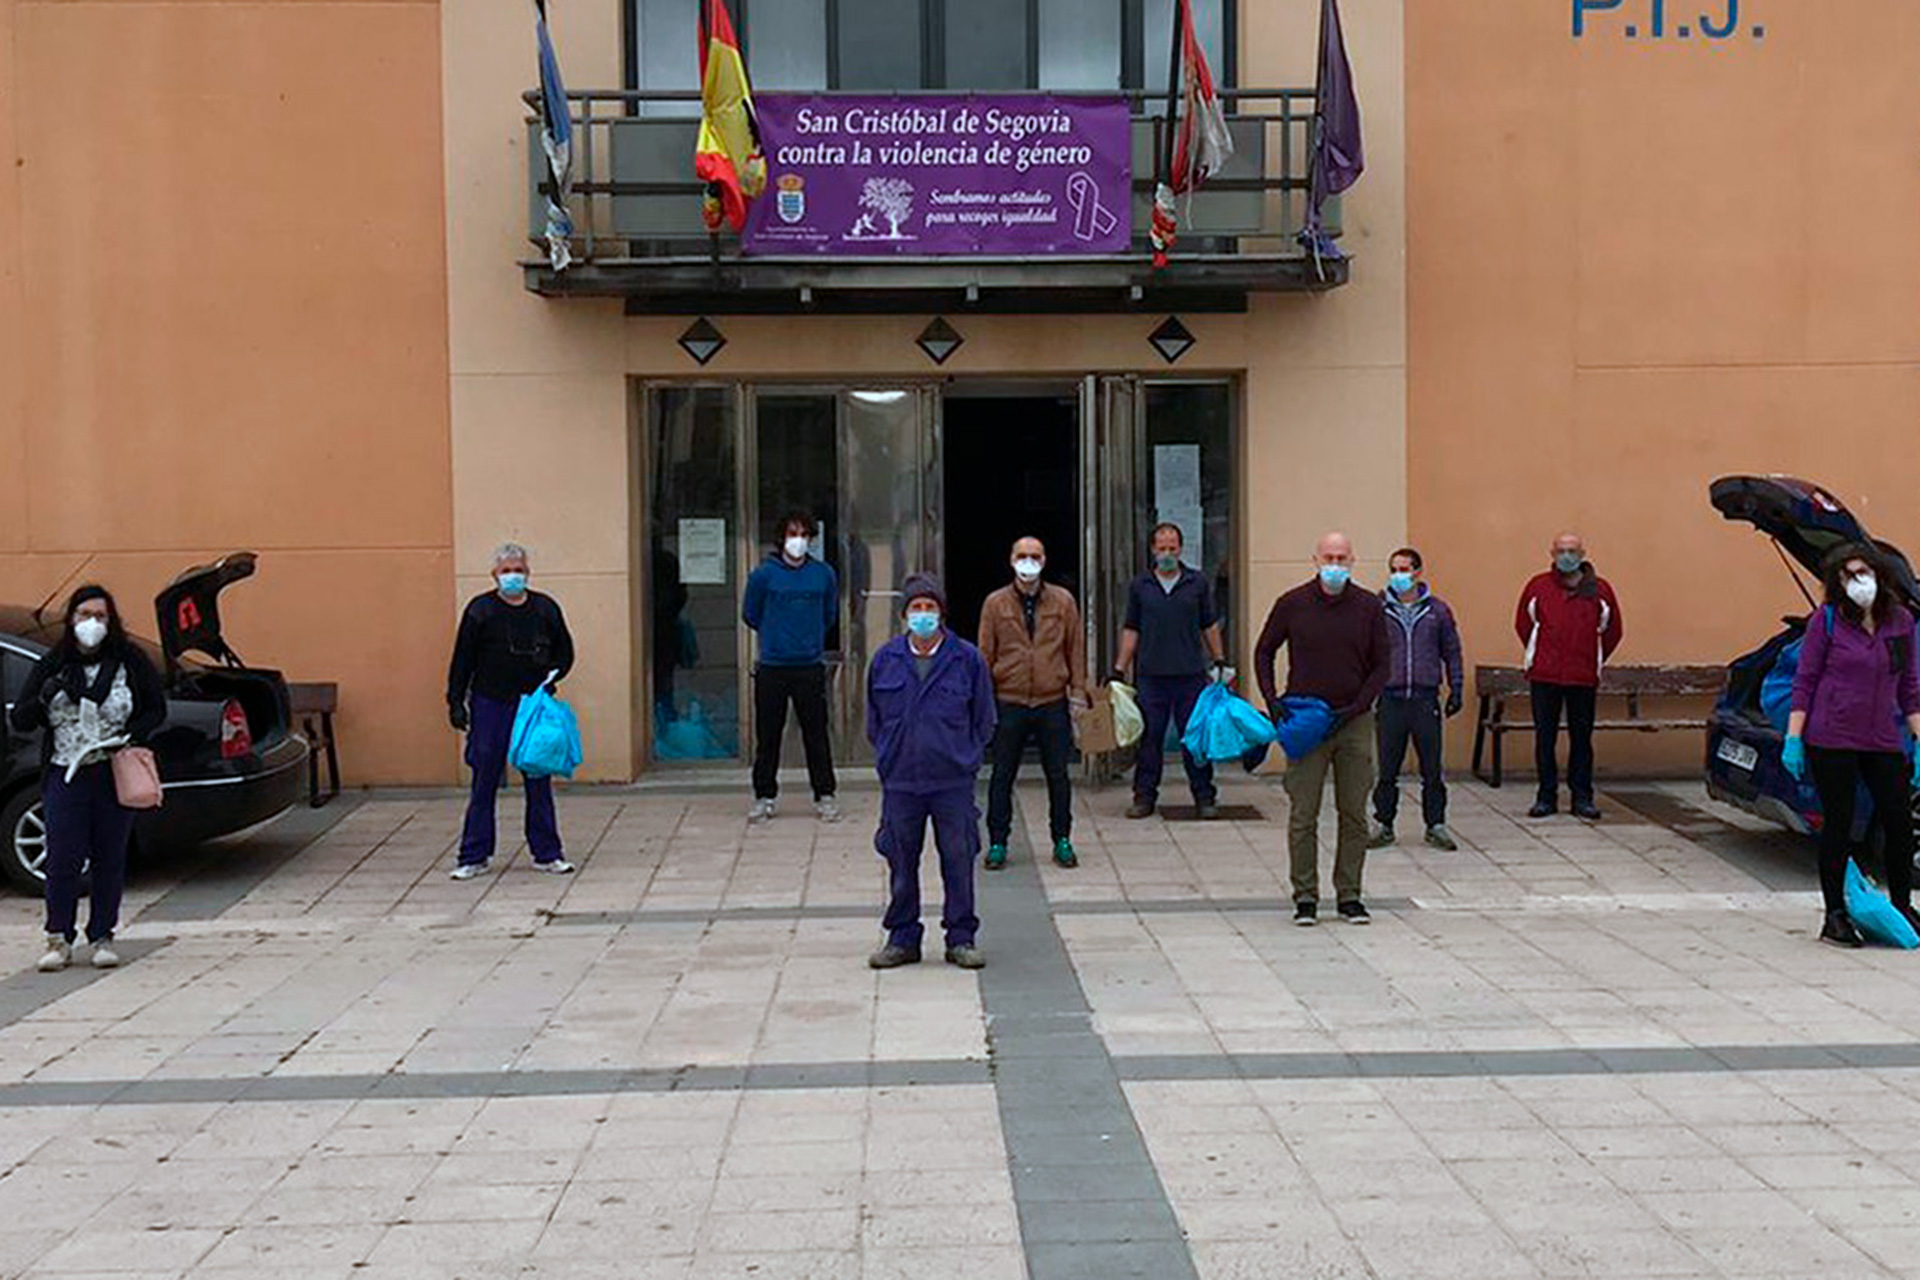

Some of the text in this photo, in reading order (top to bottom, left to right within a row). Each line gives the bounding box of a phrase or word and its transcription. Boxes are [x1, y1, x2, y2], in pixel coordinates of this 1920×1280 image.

[796, 108, 1071, 141] San Cristóbal de Segovia
[777, 140, 1091, 172] contra la violencia de género
[924, 213, 956, 228] para
[1001, 207, 1057, 227] igualdad
